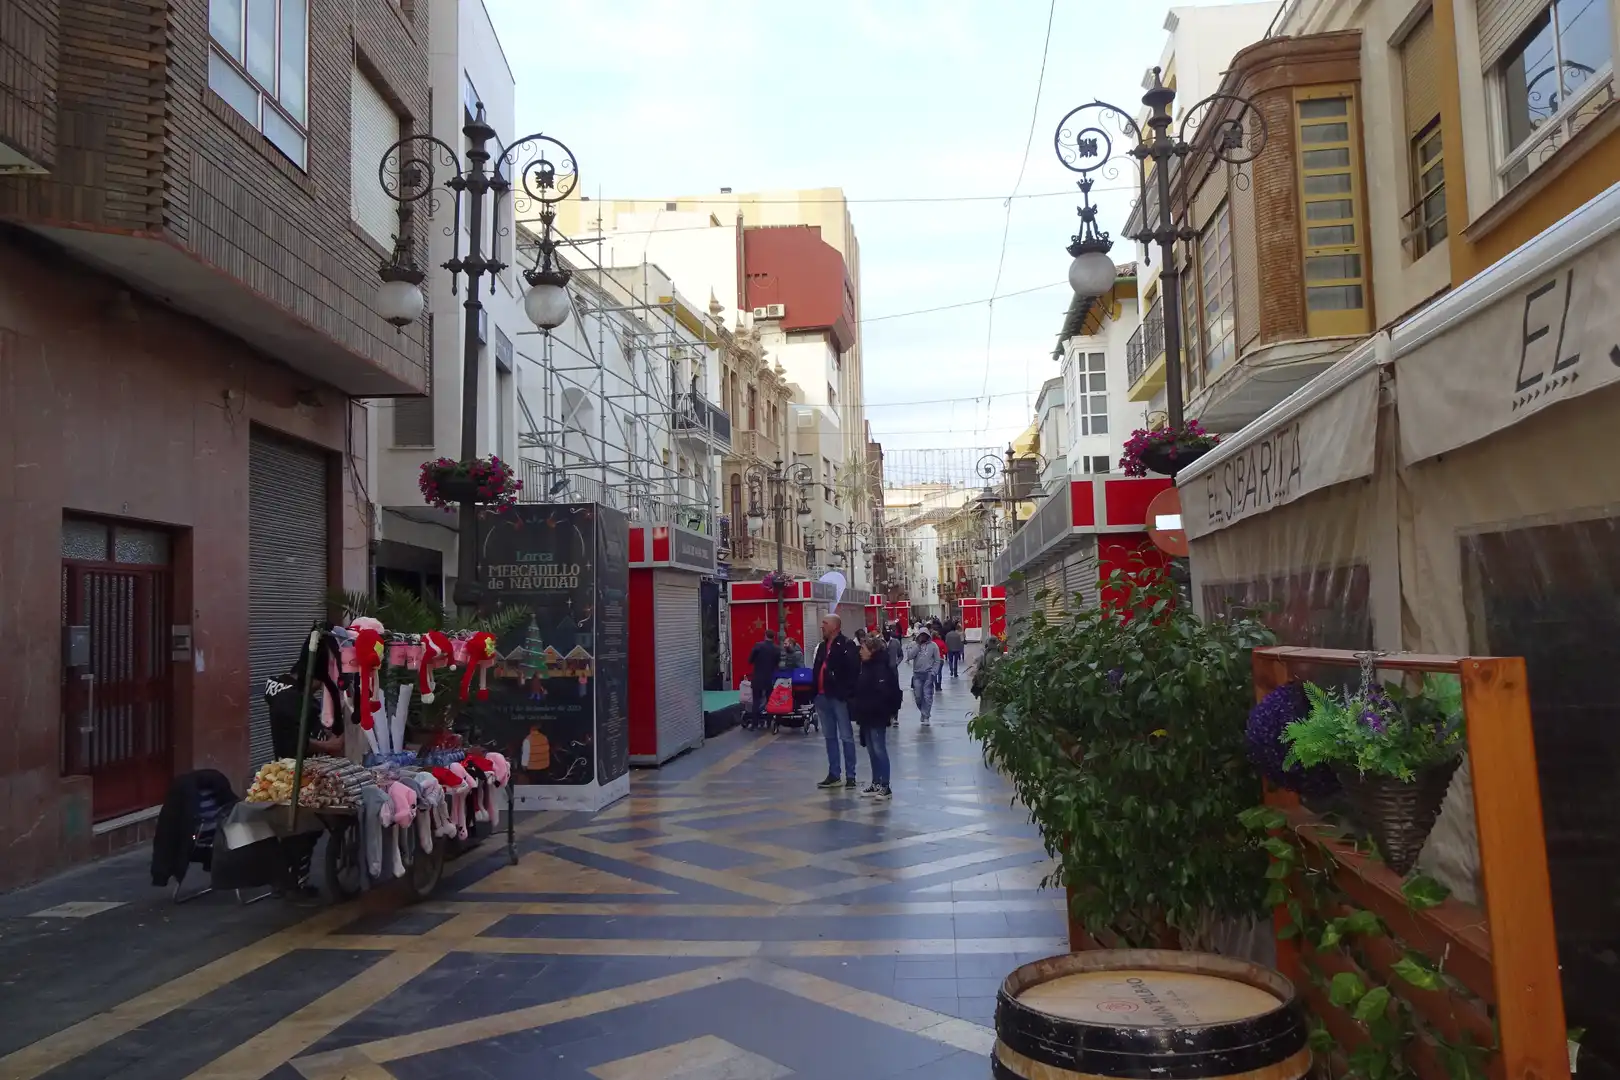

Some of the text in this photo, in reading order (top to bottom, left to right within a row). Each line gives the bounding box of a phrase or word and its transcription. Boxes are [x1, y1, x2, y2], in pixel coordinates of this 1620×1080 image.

[1515, 268, 1580, 392] EL
[1205, 422, 1302, 521] EL SIBARITA
[515, 550, 553, 562] Lorca
[488, 564, 580, 577] MERCADILLO
[487, 576, 578, 590] de NAVIDAD
